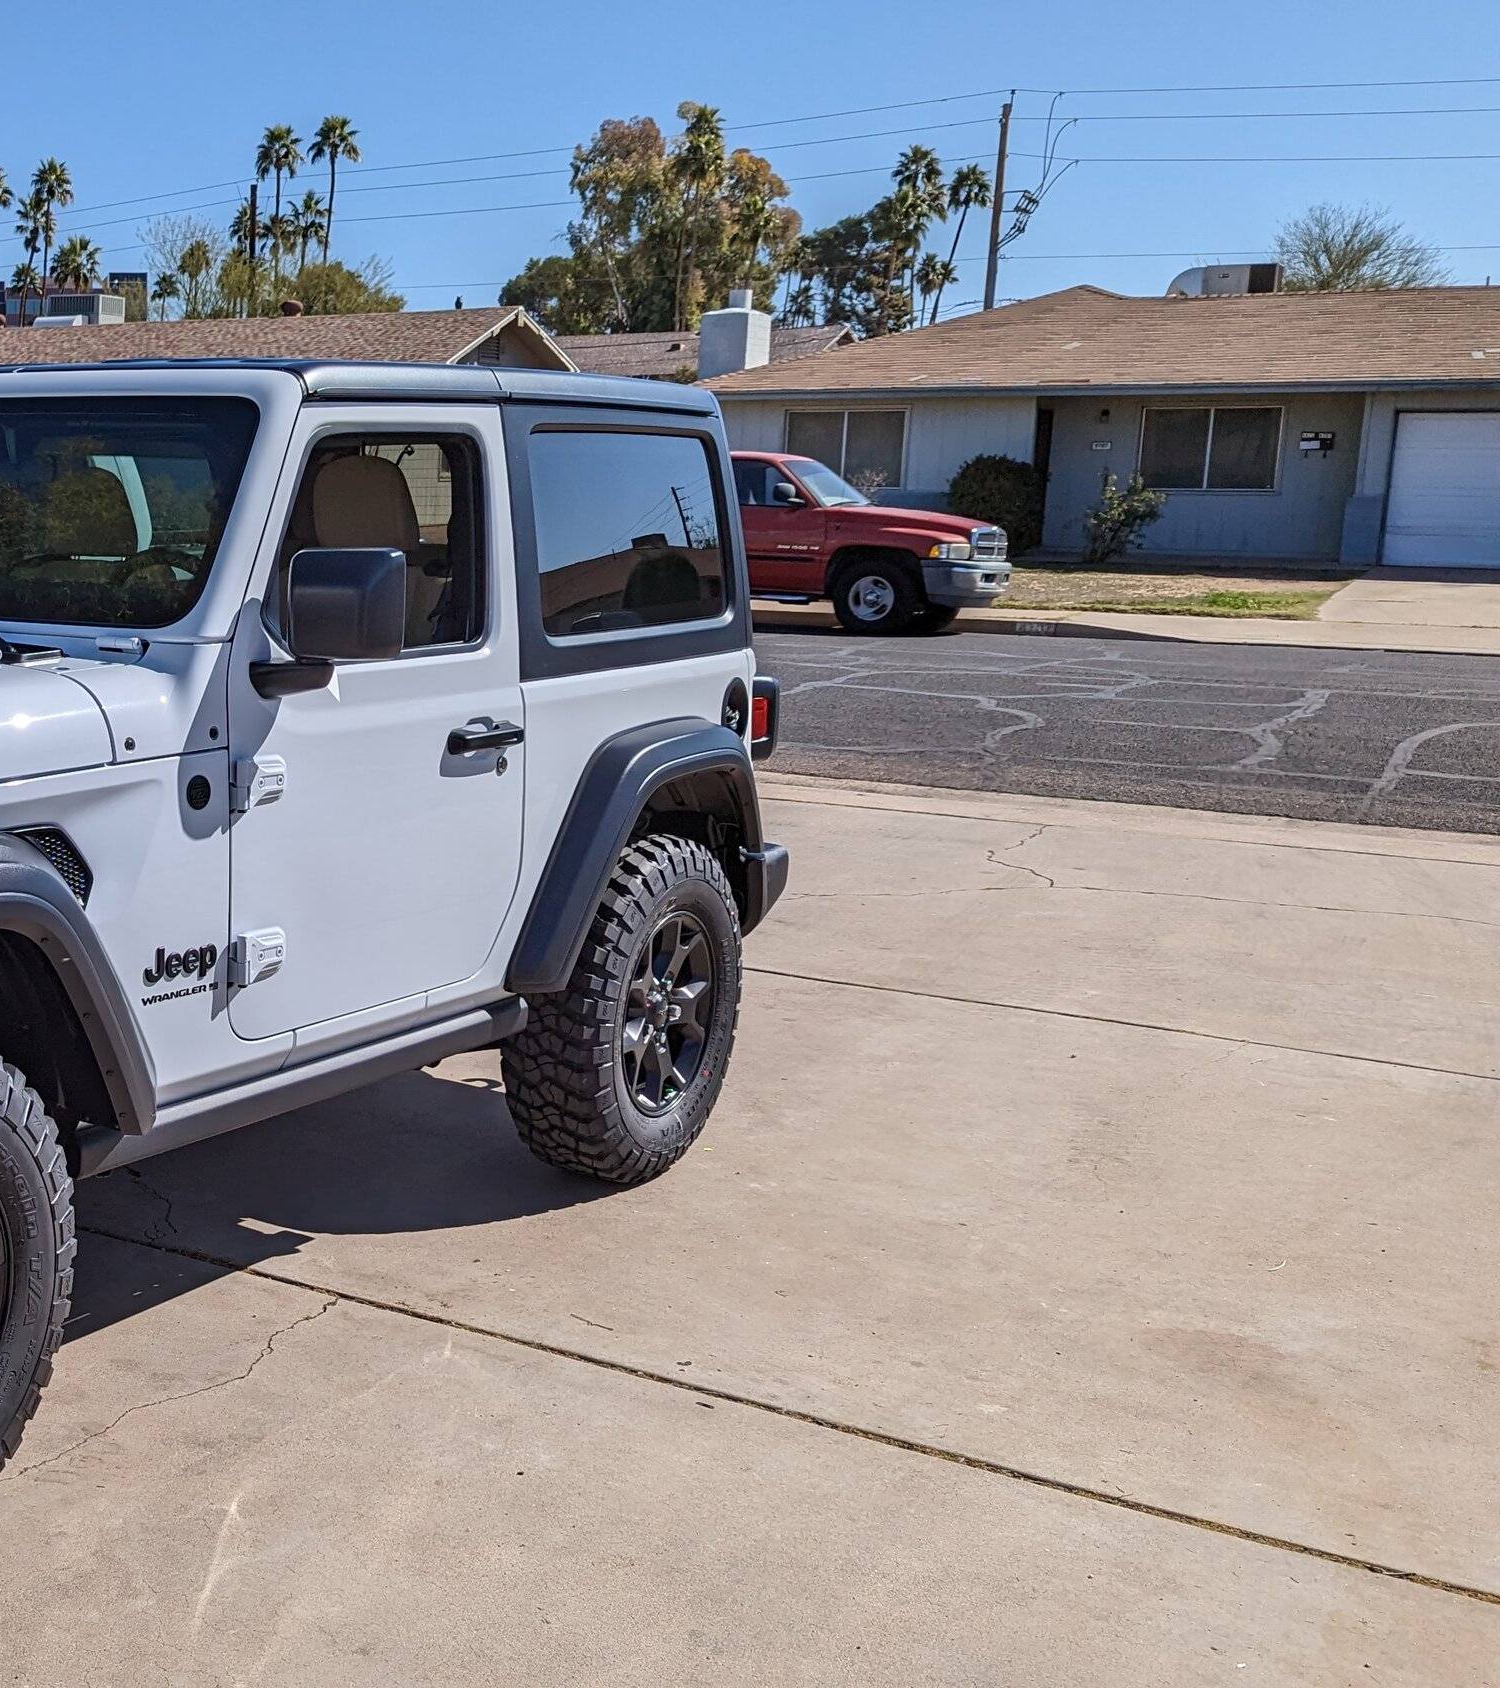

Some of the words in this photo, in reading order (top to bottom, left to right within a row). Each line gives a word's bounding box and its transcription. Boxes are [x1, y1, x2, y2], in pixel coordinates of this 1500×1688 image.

[143, 944, 217, 983] Jeep
[141, 986, 206, 1006] WRANGLER
[23, 1251, 43, 1327] T/A
